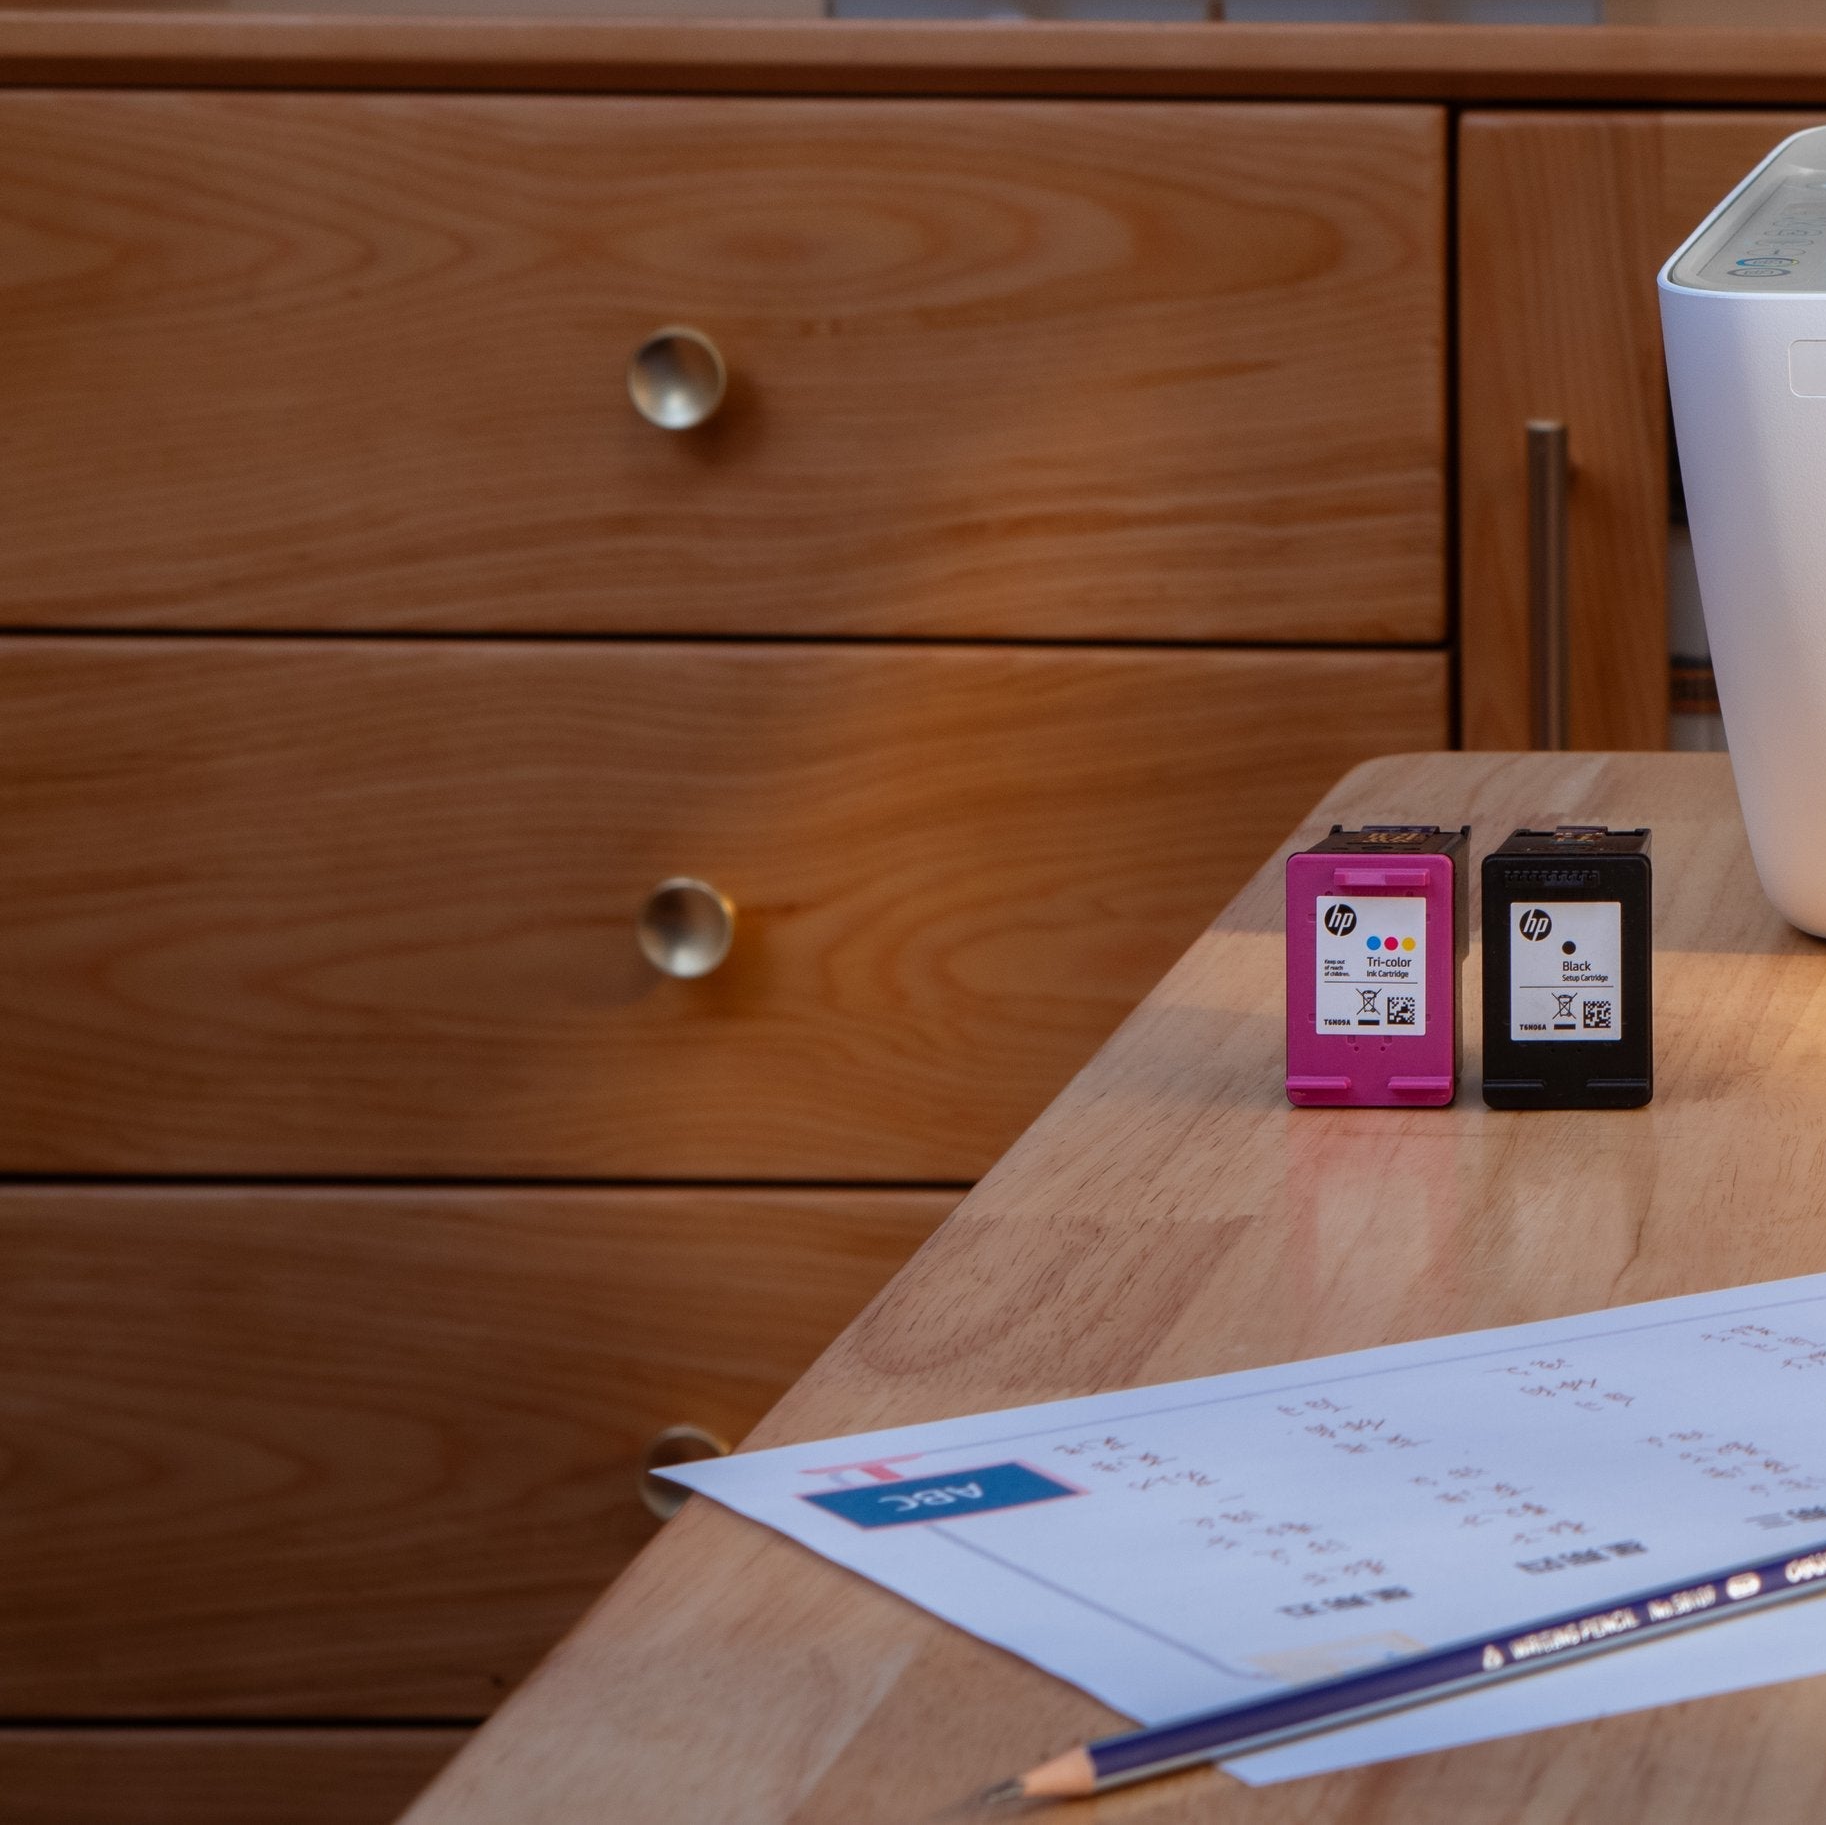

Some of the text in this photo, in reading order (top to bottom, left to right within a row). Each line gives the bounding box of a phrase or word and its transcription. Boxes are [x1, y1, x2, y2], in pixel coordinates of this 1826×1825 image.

[1326, 904, 1355, 936] hp
[1521, 909, 1550, 941] hp
[1366, 956, 1412, 968] Tri-color
[1562, 961, 1592, 972] Black
[1366, 970, 1409, 979] Ink Cartridge
[1562, 974, 1609, 983] Setup Cartridge
[878, 1481, 983, 1513] ABC
